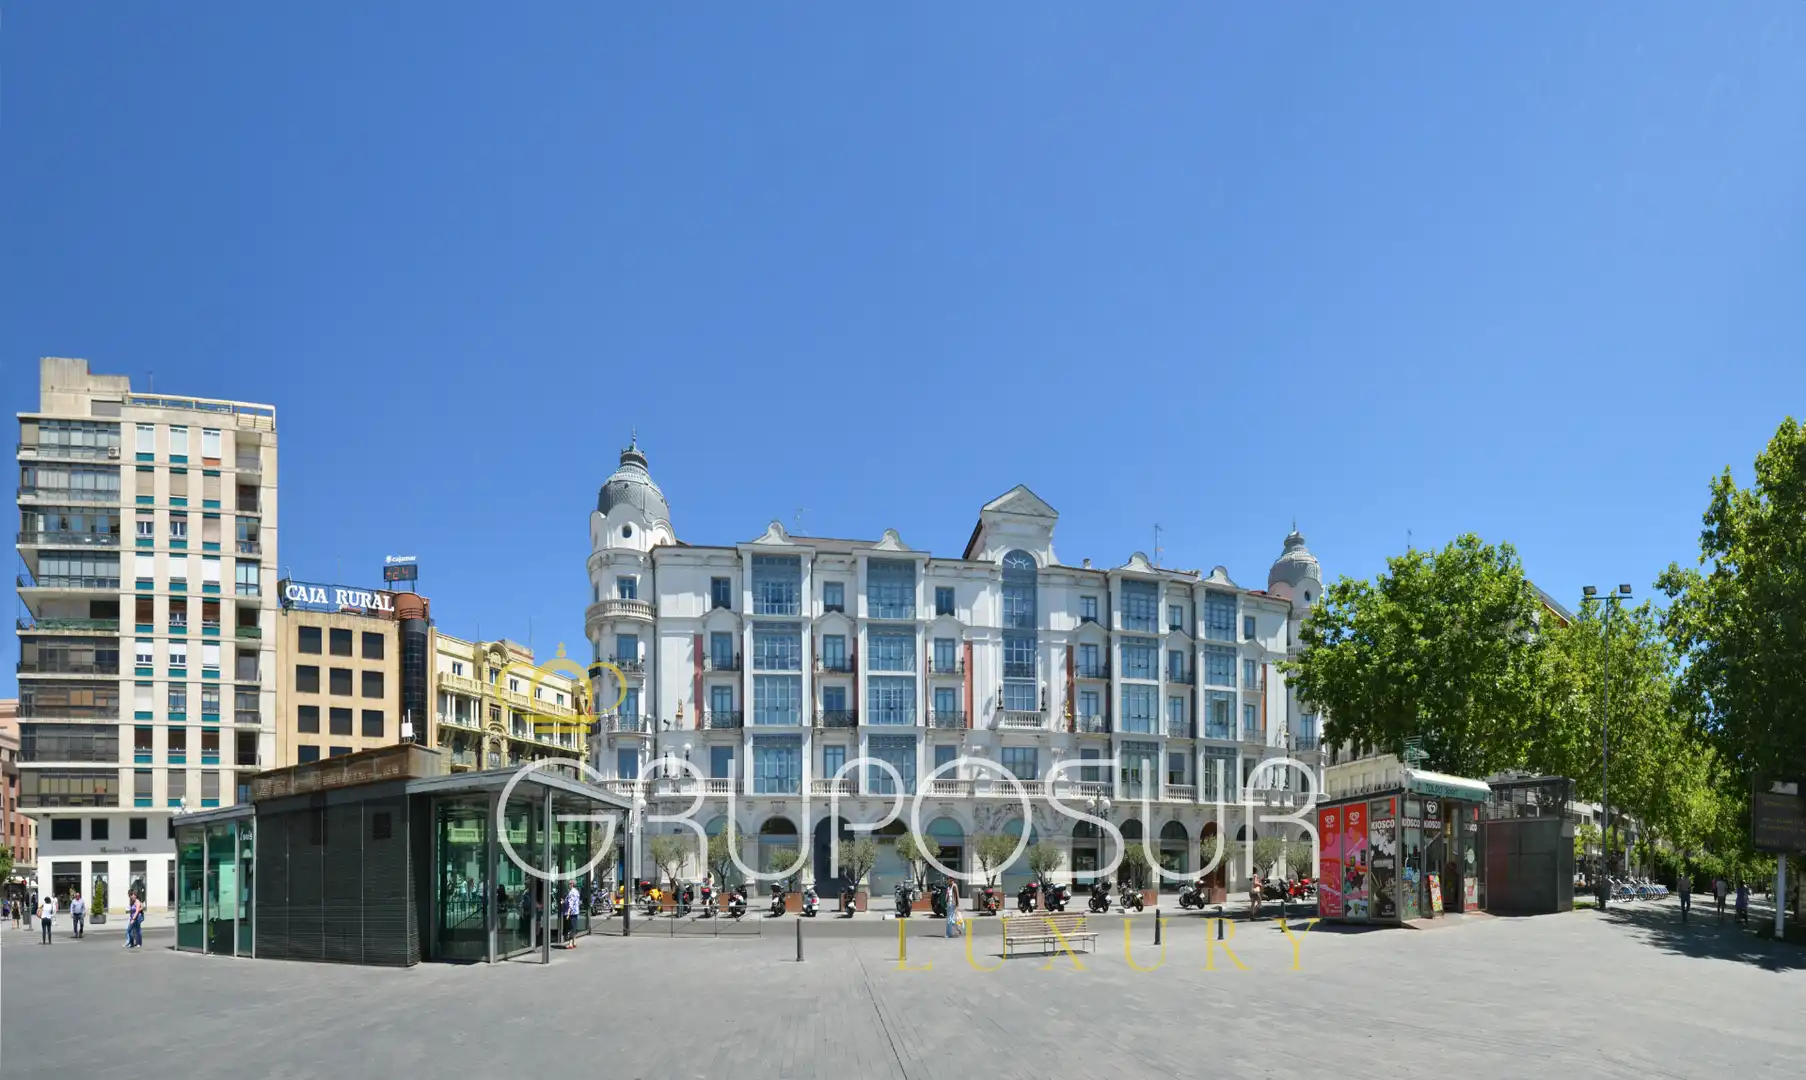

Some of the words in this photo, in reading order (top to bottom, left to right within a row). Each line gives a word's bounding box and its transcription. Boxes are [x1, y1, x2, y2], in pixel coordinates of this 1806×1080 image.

[285, 585, 328, 604] CAJA
[336, 589, 395, 612] RURAL
[1371, 820, 1395, 830] KIOSCO
[1402, 818, 1420, 828] KIOSCO
[1424, 820, 1441, 829] KIOSCO
